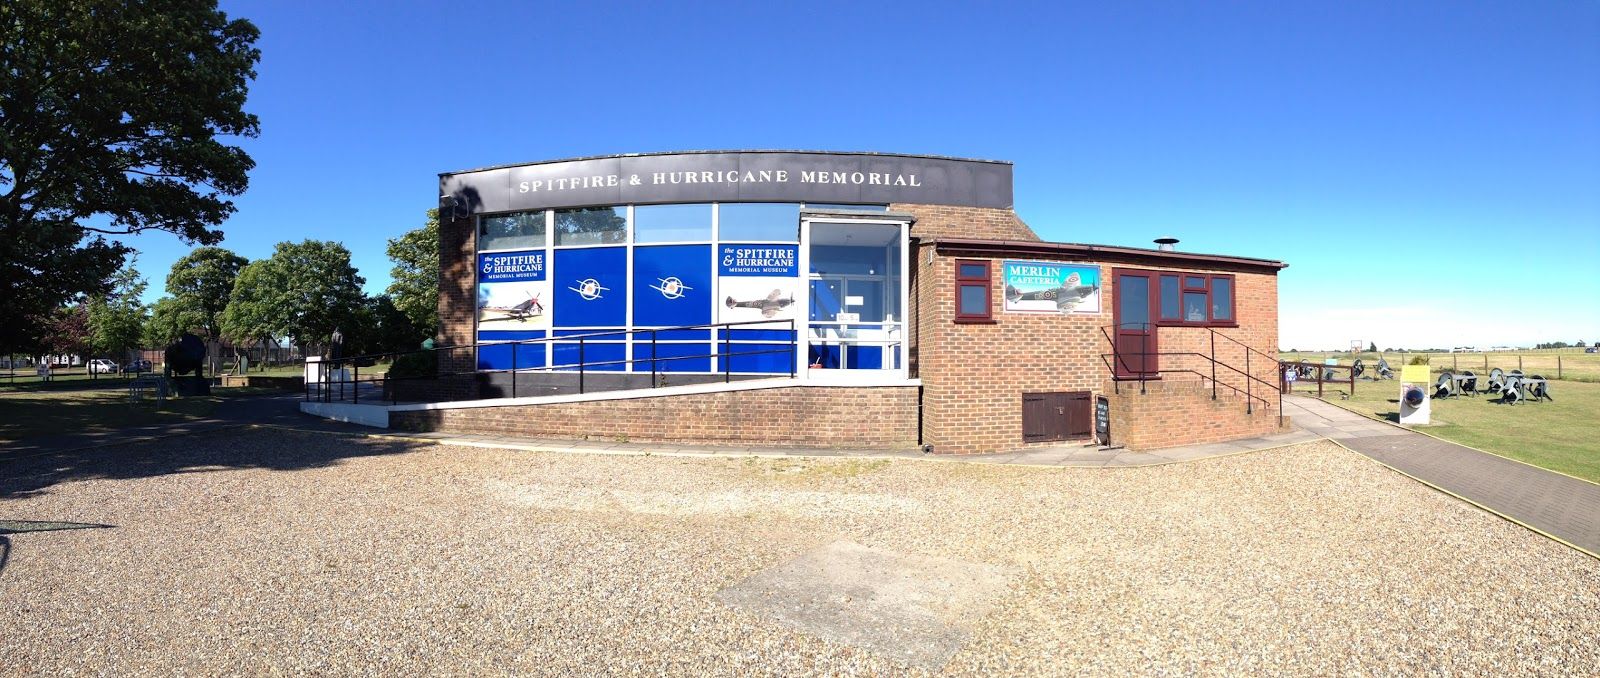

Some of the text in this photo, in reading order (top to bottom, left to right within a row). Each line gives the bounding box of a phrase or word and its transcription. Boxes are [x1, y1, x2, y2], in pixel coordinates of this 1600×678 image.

[519, 170, 922, 194] SPITFIRE & HURRICANE MEMORIAL
[736, 248, 794, 259] SPITFIRE
[494, 254, 543, 266] SPITFIRE
[723, 255, 794, 267] & HURRICANE
[483, 262, 543, 274] & HURRICANE
[1009, 265, 1061, 277] MERLIN
[1010, 276, 1060, 285] CAFETERIA
